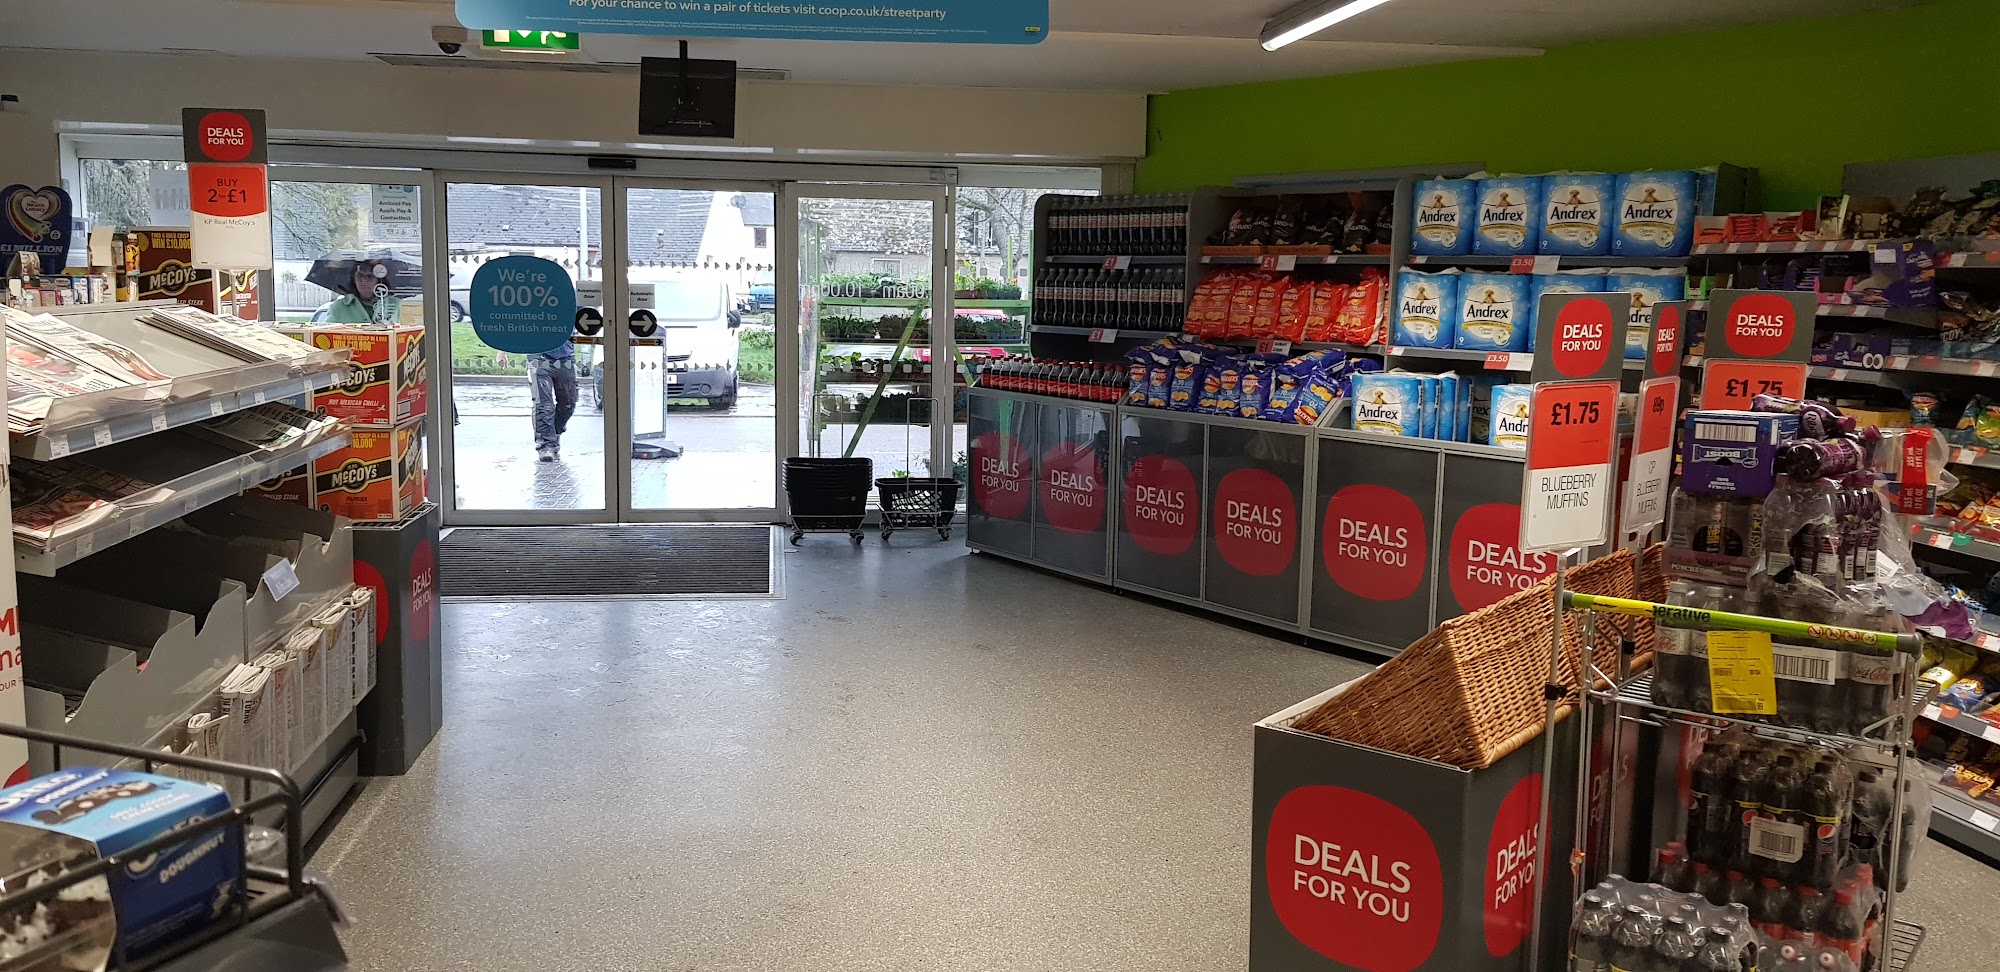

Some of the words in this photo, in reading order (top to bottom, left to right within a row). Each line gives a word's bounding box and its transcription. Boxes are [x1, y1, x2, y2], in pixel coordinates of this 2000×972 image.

[591, 0, 618, 10] your
[620, 0, 662, 10] chance
[664, 2, 676, 10] to
[680, 1, 700, 11] win
[713, 2, 736, 14] pair
[739, 2, 751, 13] of
[753, 3, 791, 15] tickets
[793, 4, 817, 15] visit
[818, 5, 947, 21] coop.co.uk/streetparty
[207, 127, 244, 138] DEALS
[226, 138, 244, 146] YOU
[217, 178, 238, 187] BUY
[208, 188, 218, 203] 2
[227, 188, 247, 203] £1
[1420, 210, 1456, 222] Andrex
[1483, 208, 1523, 222] Andrex
[1550, 206, 1597, 220] Andrex
[1624, 204, 1673, 219] Andrex
[229, 219, 256, 227] McCoy's
[12, 245, 64, 253] MILLION
[1542, 240, 1548, 248] 9
[1616, 239, 1622, 247] 9
[1104, 257, 1115, 266] £1
[1263, 257, 1275, 268] £1
[1512, 258, 1533, 266] £3.50
[498, 268, 547, 283] We're
[488, 285, 559, 307] 100%
[1402, 301, 1437, 315] Andrex
[1466, 304, 1509, 319] Andrex
[489, 311, 545, 321] committed
[548, 312, 557, 321] to
[1737, 313, 1784, 328] DEALS
[480, 322, 505, 332] fresh
[507, 322, 540, 332] British
[543, 324, 568, 333] meat
[1562, 323, 1603, 339] DEALS
[1657, 327, 1676, 342] DEALS
[1735, 327, 1757, 337] FOR
[1760, 328, 1782, 337] YOU
[1260, 341, 1270, 352] £1
[1561, 340, 1579, 352] FOR
[1579, 339, 1602, 351] YOU
[1656, 343, 1666, 353] FOR
[1725, 378, 1784, 398] £1.75
[1359, 404, 1398, 420] Andrex
[1473, 405, 1490, 416] rex
[1551, 400, 1600, 426] £1.75
[1499, 417, 1528, 433] Andr
[352, 438, 373, 449] 10,000
[1704, 450, 1741, 458] BOOST
[1907, 455, 1915, 467] 355
[981, 456, 1020, 478] DEALS
[981, 475, 999, 488] FOR
[999, 478, 1019, 493] YOU
[1051, 469, 1093, 493] DEALS
[1541, 473, 1598, 493] BLUEBERRY
[1050, 488, 1070, 503] FOR
[1071, 492, 1093, 508] YOU
[1136, 485, 1185, 510] DEALS
[1546, 491, 1589, 511] MUFFINS
[1904, 497, 1913, 508] 355
[1135, 505, 1158, 521] FOR
[1159, 509, 1184, 526] YOU
[1227, 500, 1282, 528] DEALS
[1226, 522, 1252, 539] FOR
[1253, 527, 1282, 545] YOU
[1339, 518, 1409, 549] DEALS
[1338, 541, 1370, 561] FOR
[1372, 547, 1407, 568] YOU
[1467, 539, 1547, 574] DEALS
[412, 567, 432, 598] DEALS
[1466, 565, 1503, 586] FOR
[412, 595, 423, 614] FOR
[1295, 833, 1411, 894] DEALS
[1293, 869, 1346, 905] FOR
[1351, 886, 1410, 923] YOU
[1495, 876, 1518, 910] FOR
